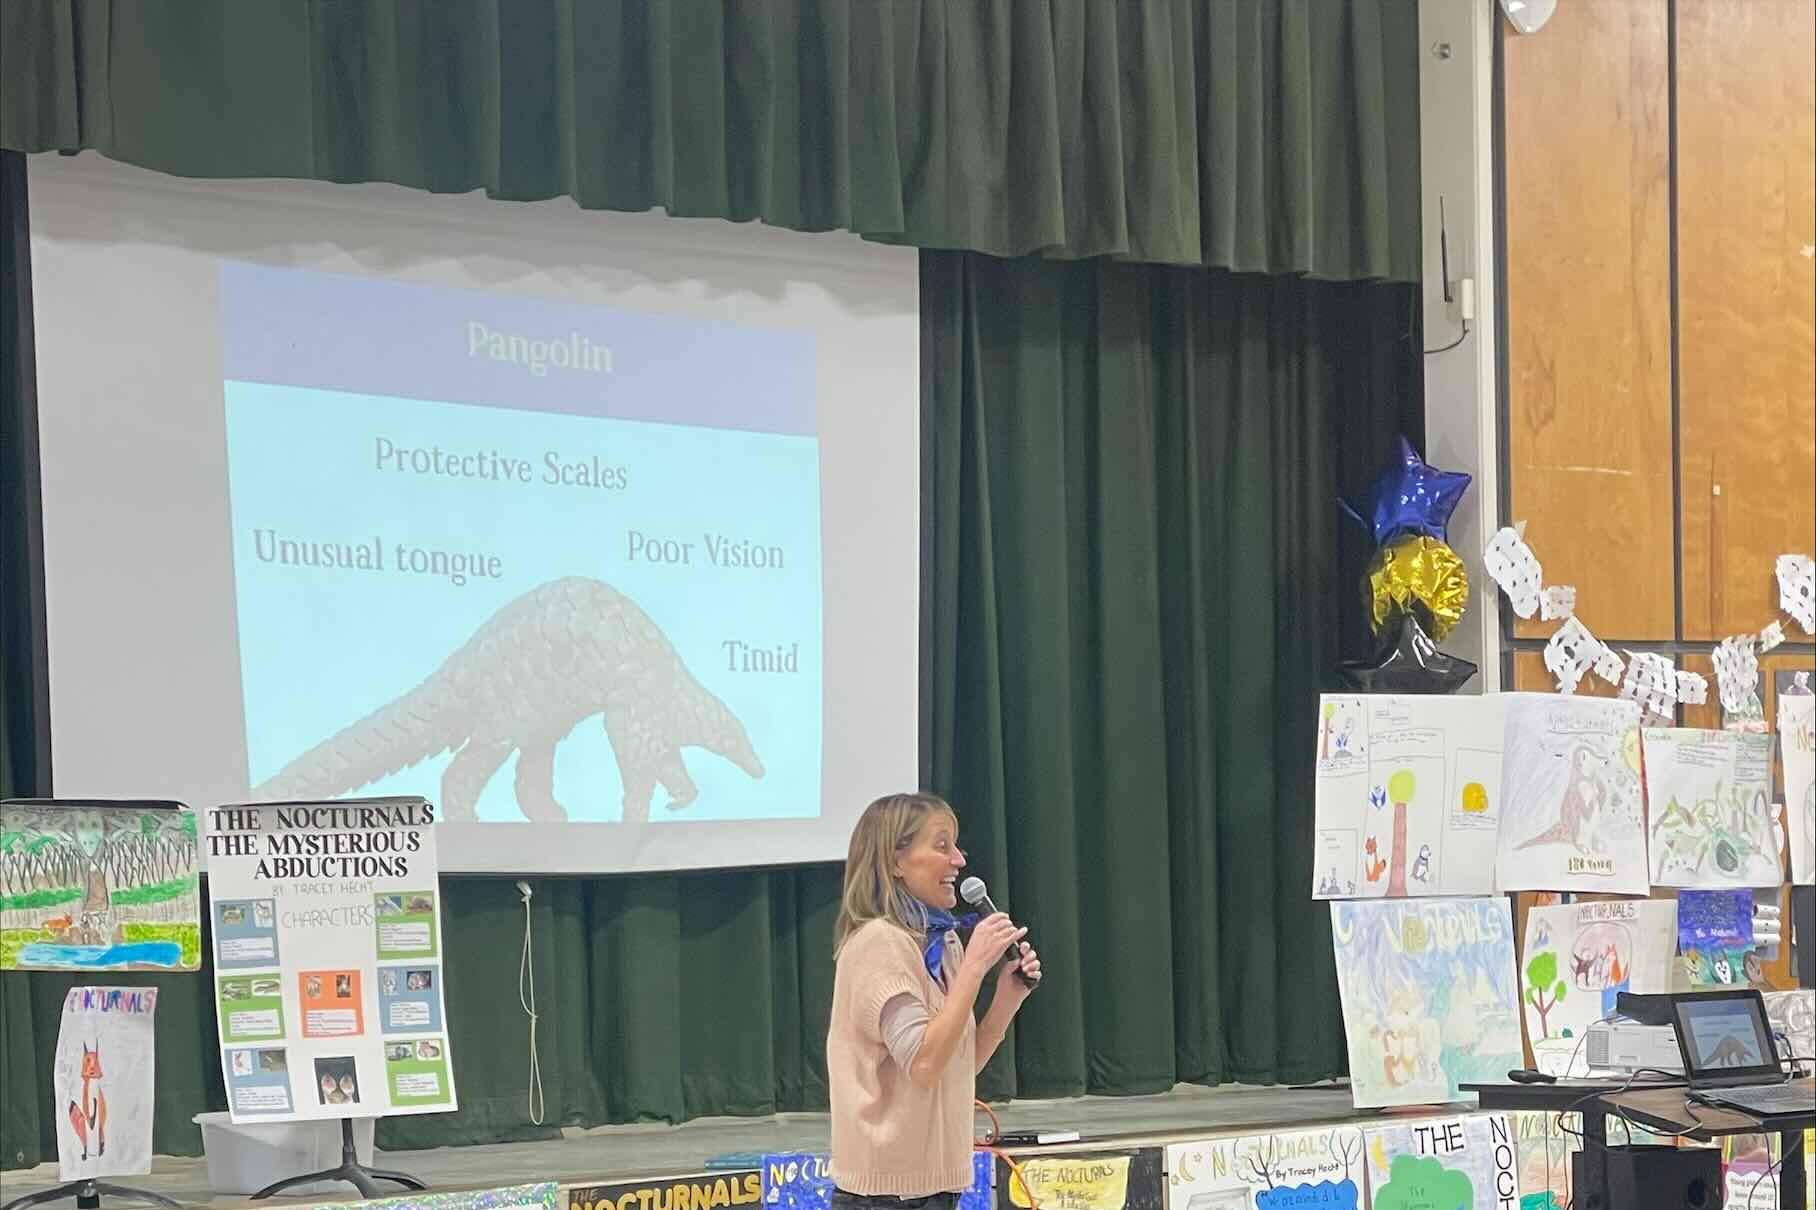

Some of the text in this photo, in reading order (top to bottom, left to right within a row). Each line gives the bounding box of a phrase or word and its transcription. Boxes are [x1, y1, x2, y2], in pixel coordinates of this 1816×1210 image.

[466, 321, 613, 376] Pangolin
[375, 437, 628, 490] Protective Scales
[253, 529, 502, 586] Unusual tongue
[628, 530, 784, 568] Poor Vision
[722, 641, 799, 673] Timid
[209, 804, 435, 831] THE NOCTURNALS
[207, 831, 421, 856] THE MYSTERIOUS
[254, 857, 408, 879] ABDUCTIONS
[281, 904, 374, 928] CHARACTERS
[1414, 1124, 1465, 1155] THE
